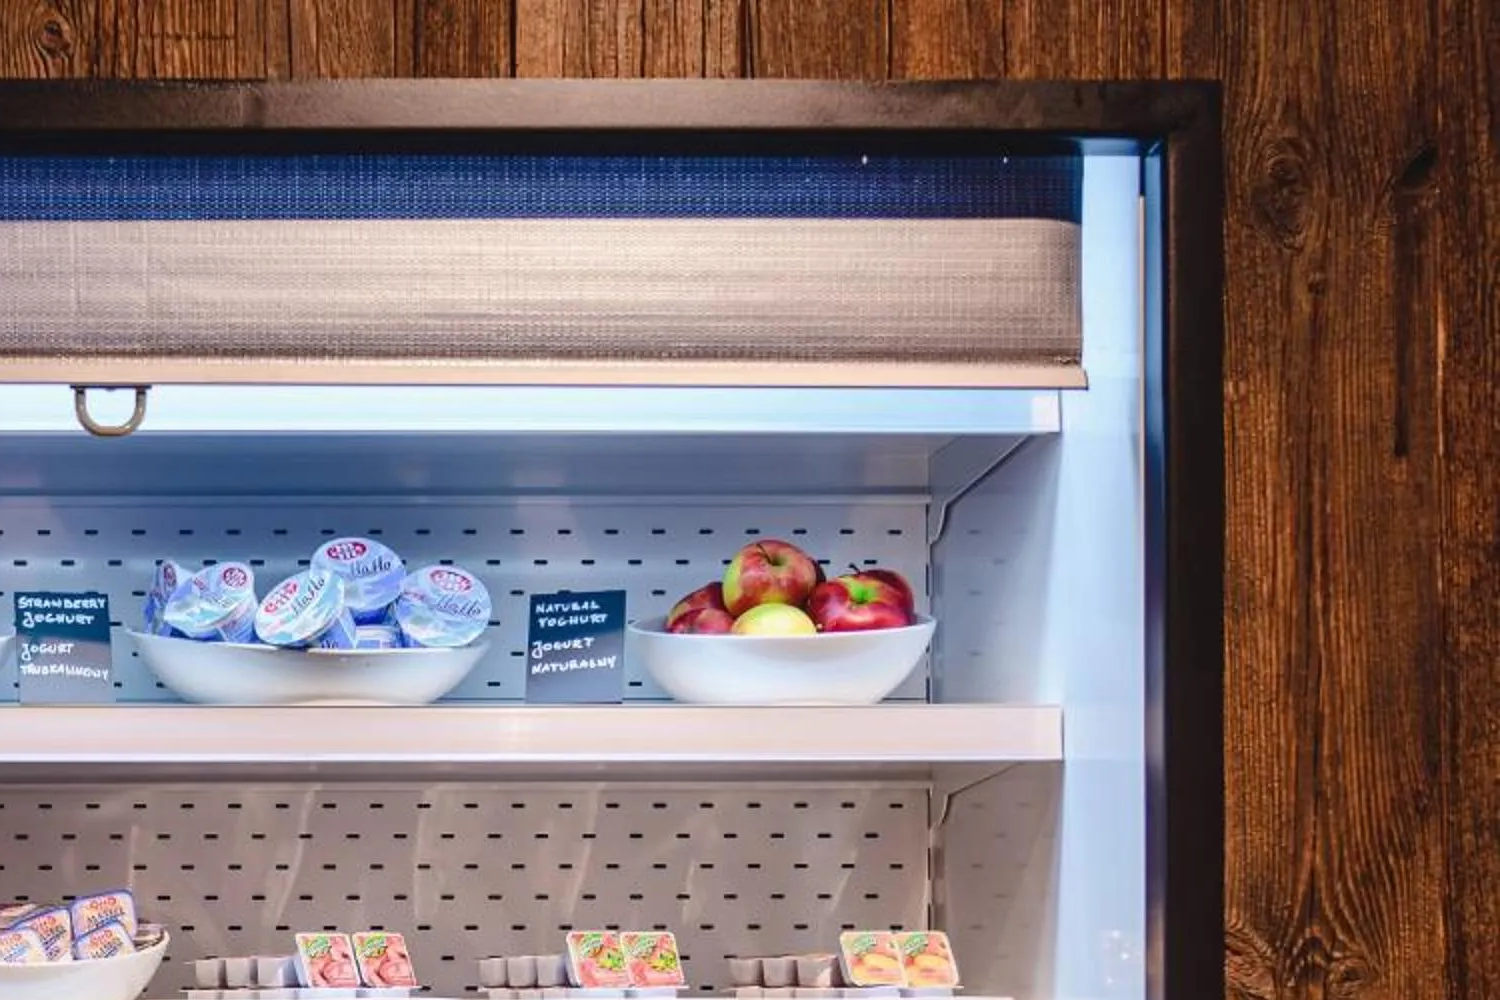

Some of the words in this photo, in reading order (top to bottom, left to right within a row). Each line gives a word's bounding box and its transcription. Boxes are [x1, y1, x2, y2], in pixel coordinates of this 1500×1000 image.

[535, 600, 600, 614] NATURAL
[21, 643, 75, 662] JOGURT
[531, 637, 595, 659] JOGURT
[531, 655, 617, 675] NATURALNY
